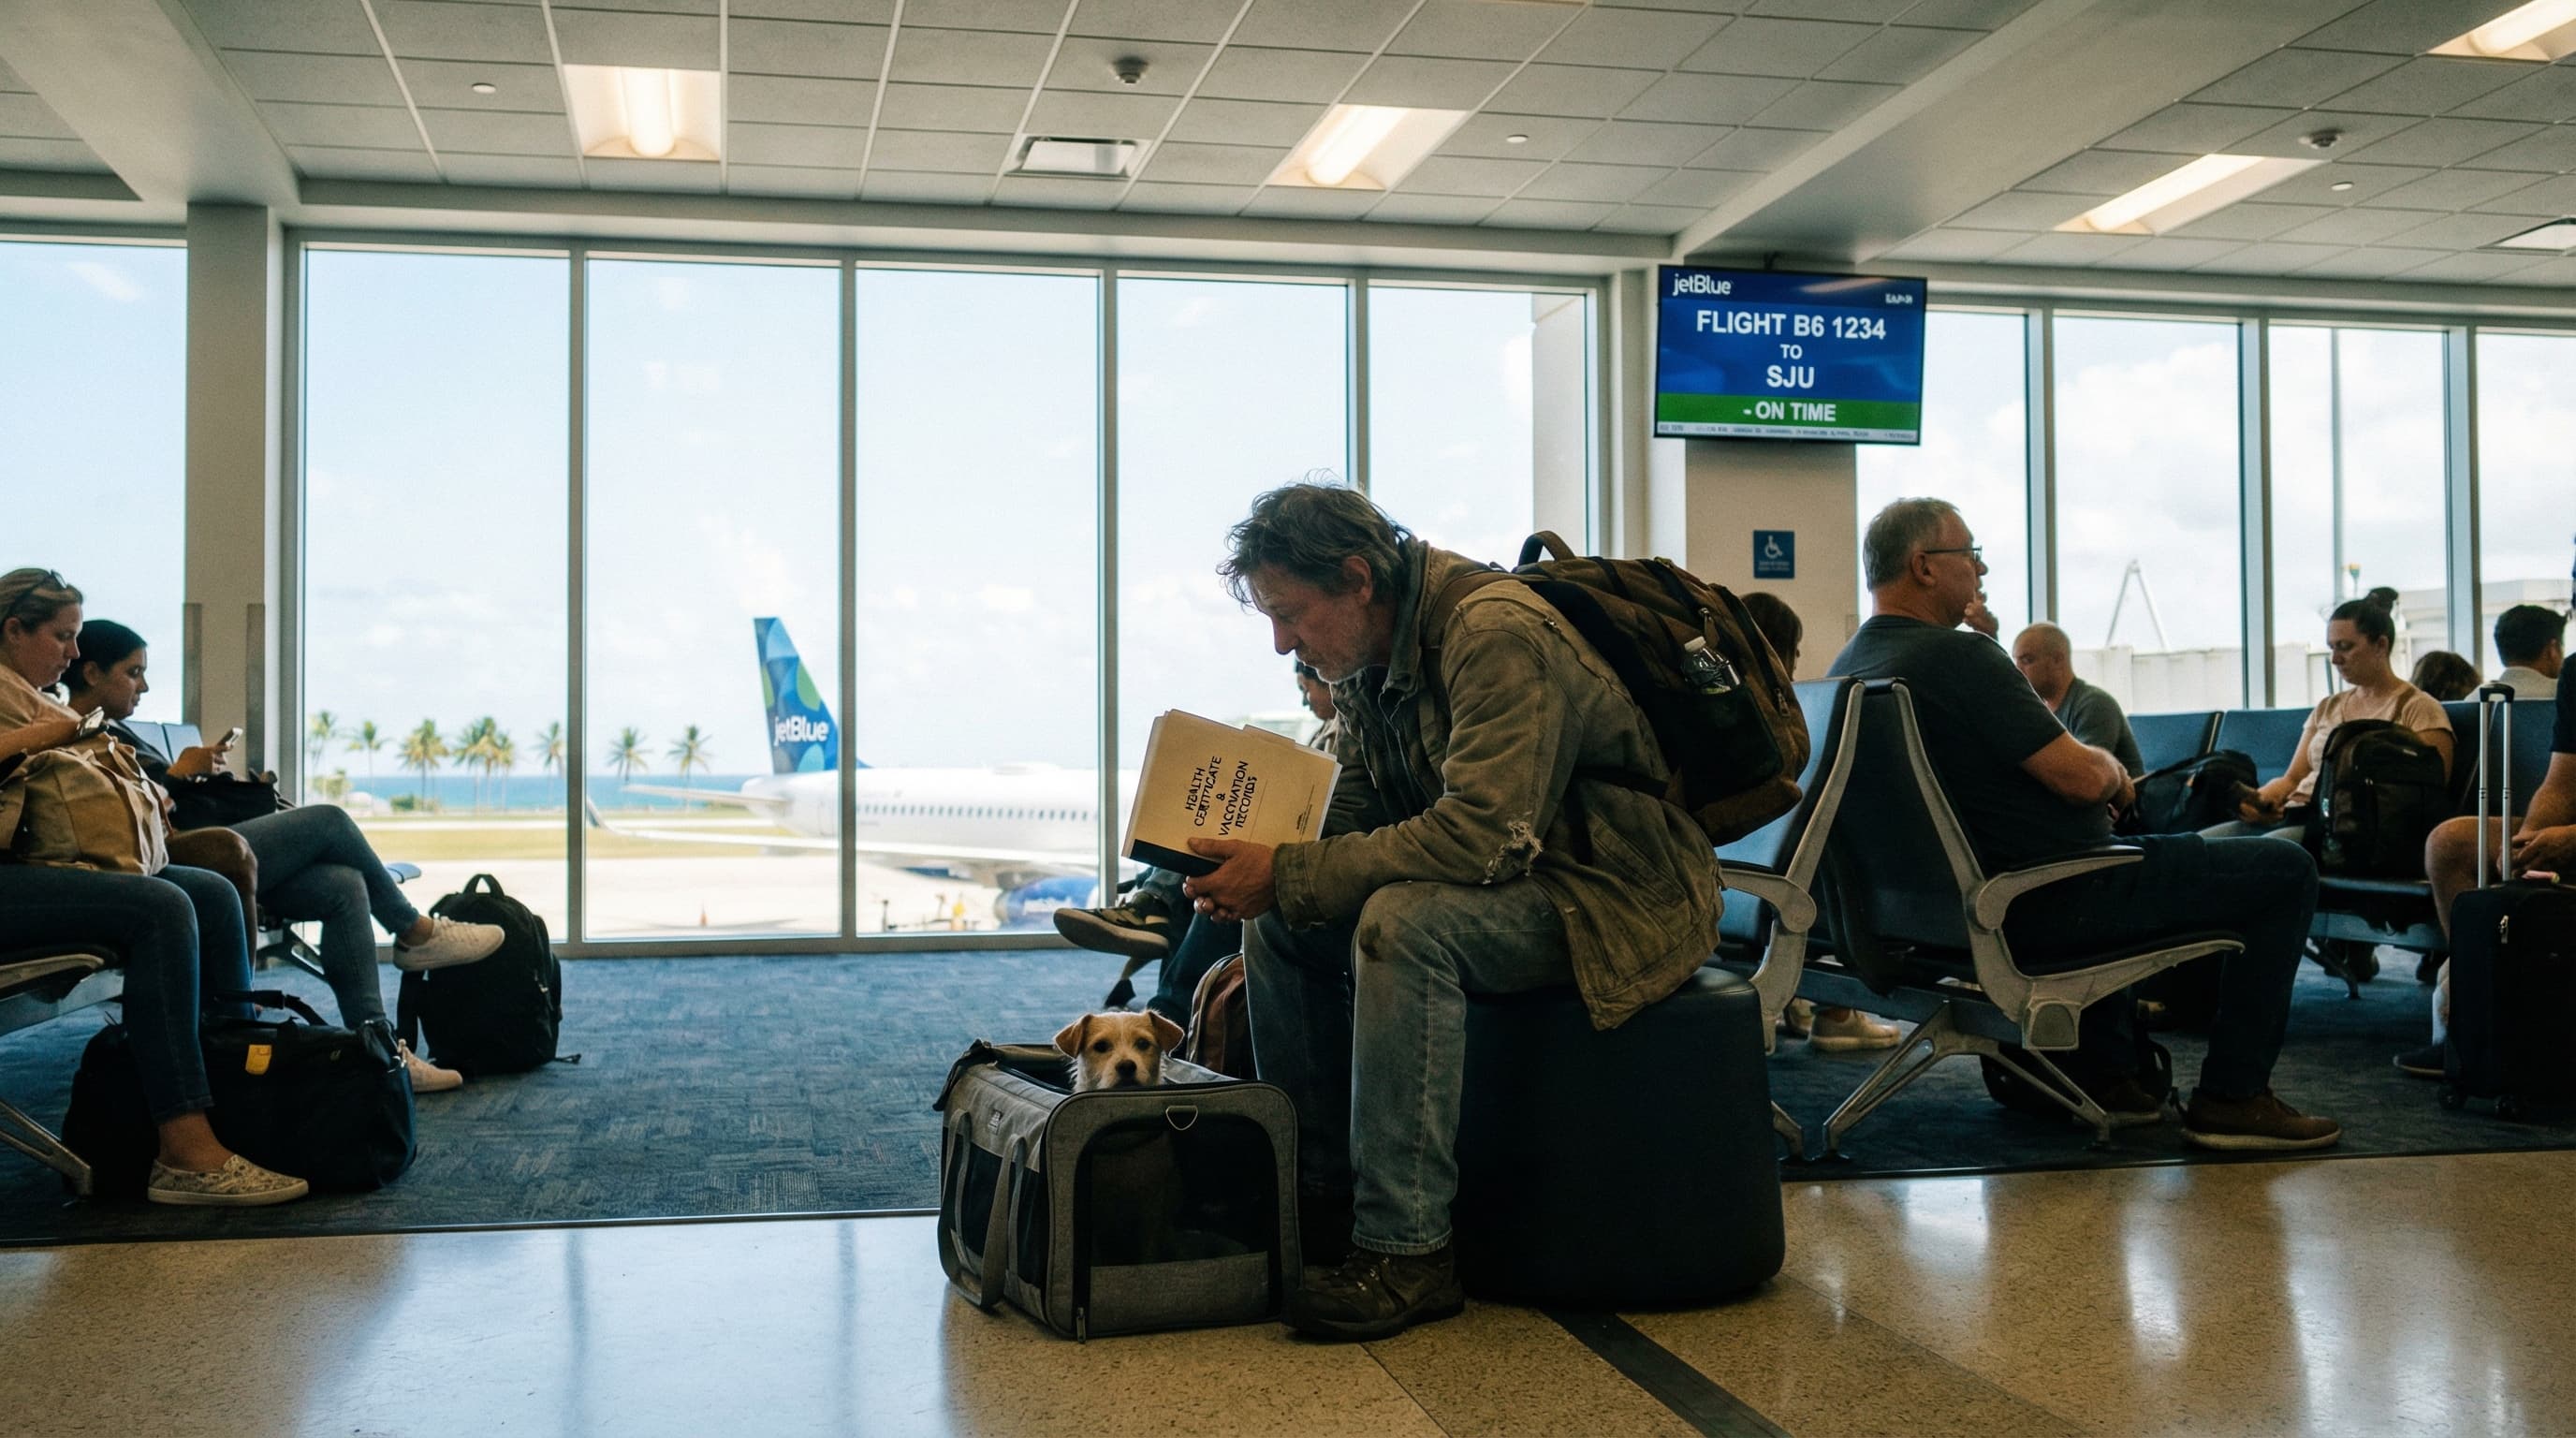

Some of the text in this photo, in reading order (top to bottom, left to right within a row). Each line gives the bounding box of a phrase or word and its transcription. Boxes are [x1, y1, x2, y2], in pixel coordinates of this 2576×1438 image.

[1672, 273, 1732, 297] jetBlue
[1696, 310, 1886, 340] FLIGHT B6 1234
[1780, 344, 1803, 360] TO
[1766, 364, 1815, 389] SJU
[1755, 401, 1785, 420] ON
[1790, 402, 1837, 421] TIME
[773, 715, 829, 747] jetBlue
[1216, 793, 1225, 801] &
